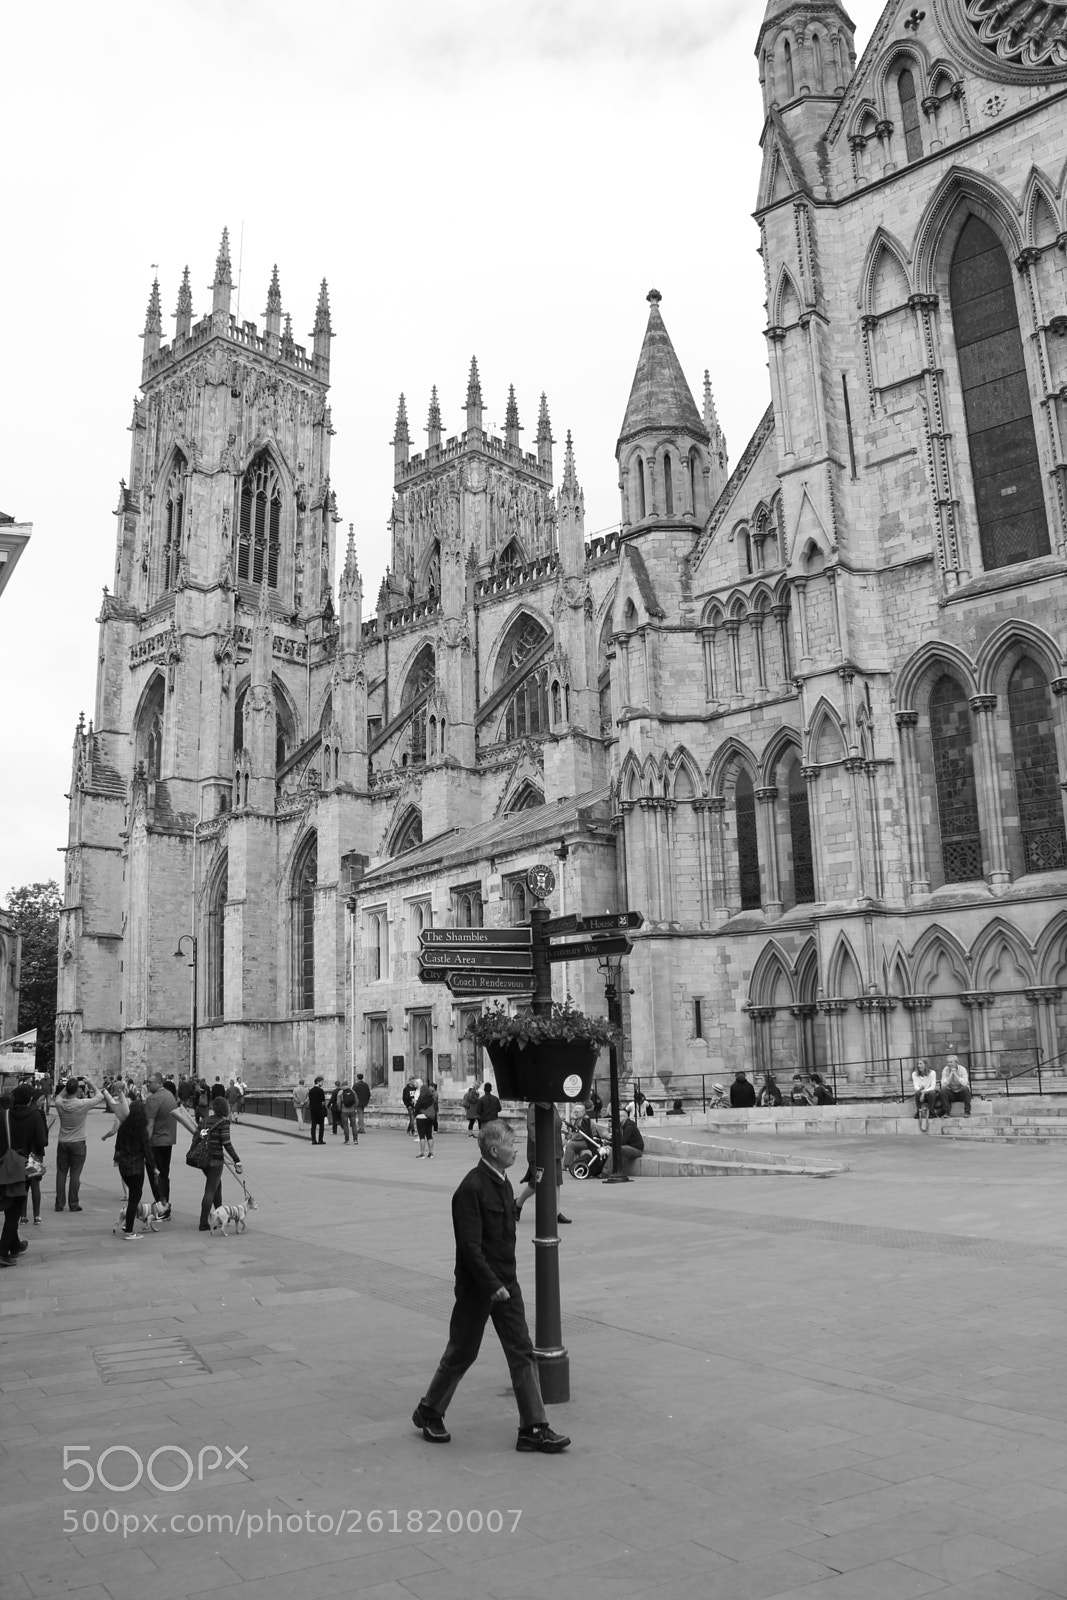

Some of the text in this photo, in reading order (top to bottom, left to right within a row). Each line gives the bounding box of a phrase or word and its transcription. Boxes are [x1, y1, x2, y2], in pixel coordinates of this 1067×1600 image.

[590, 919, 615, 929] House
[425, 931, 488, 941] The Shambles
[584, 944, 598, 954] Way
[424, 953, 476, 964] Castle Area
[423, 969, 442, 981] City
[453, 976, 524, 988] Coach Rendezvous
